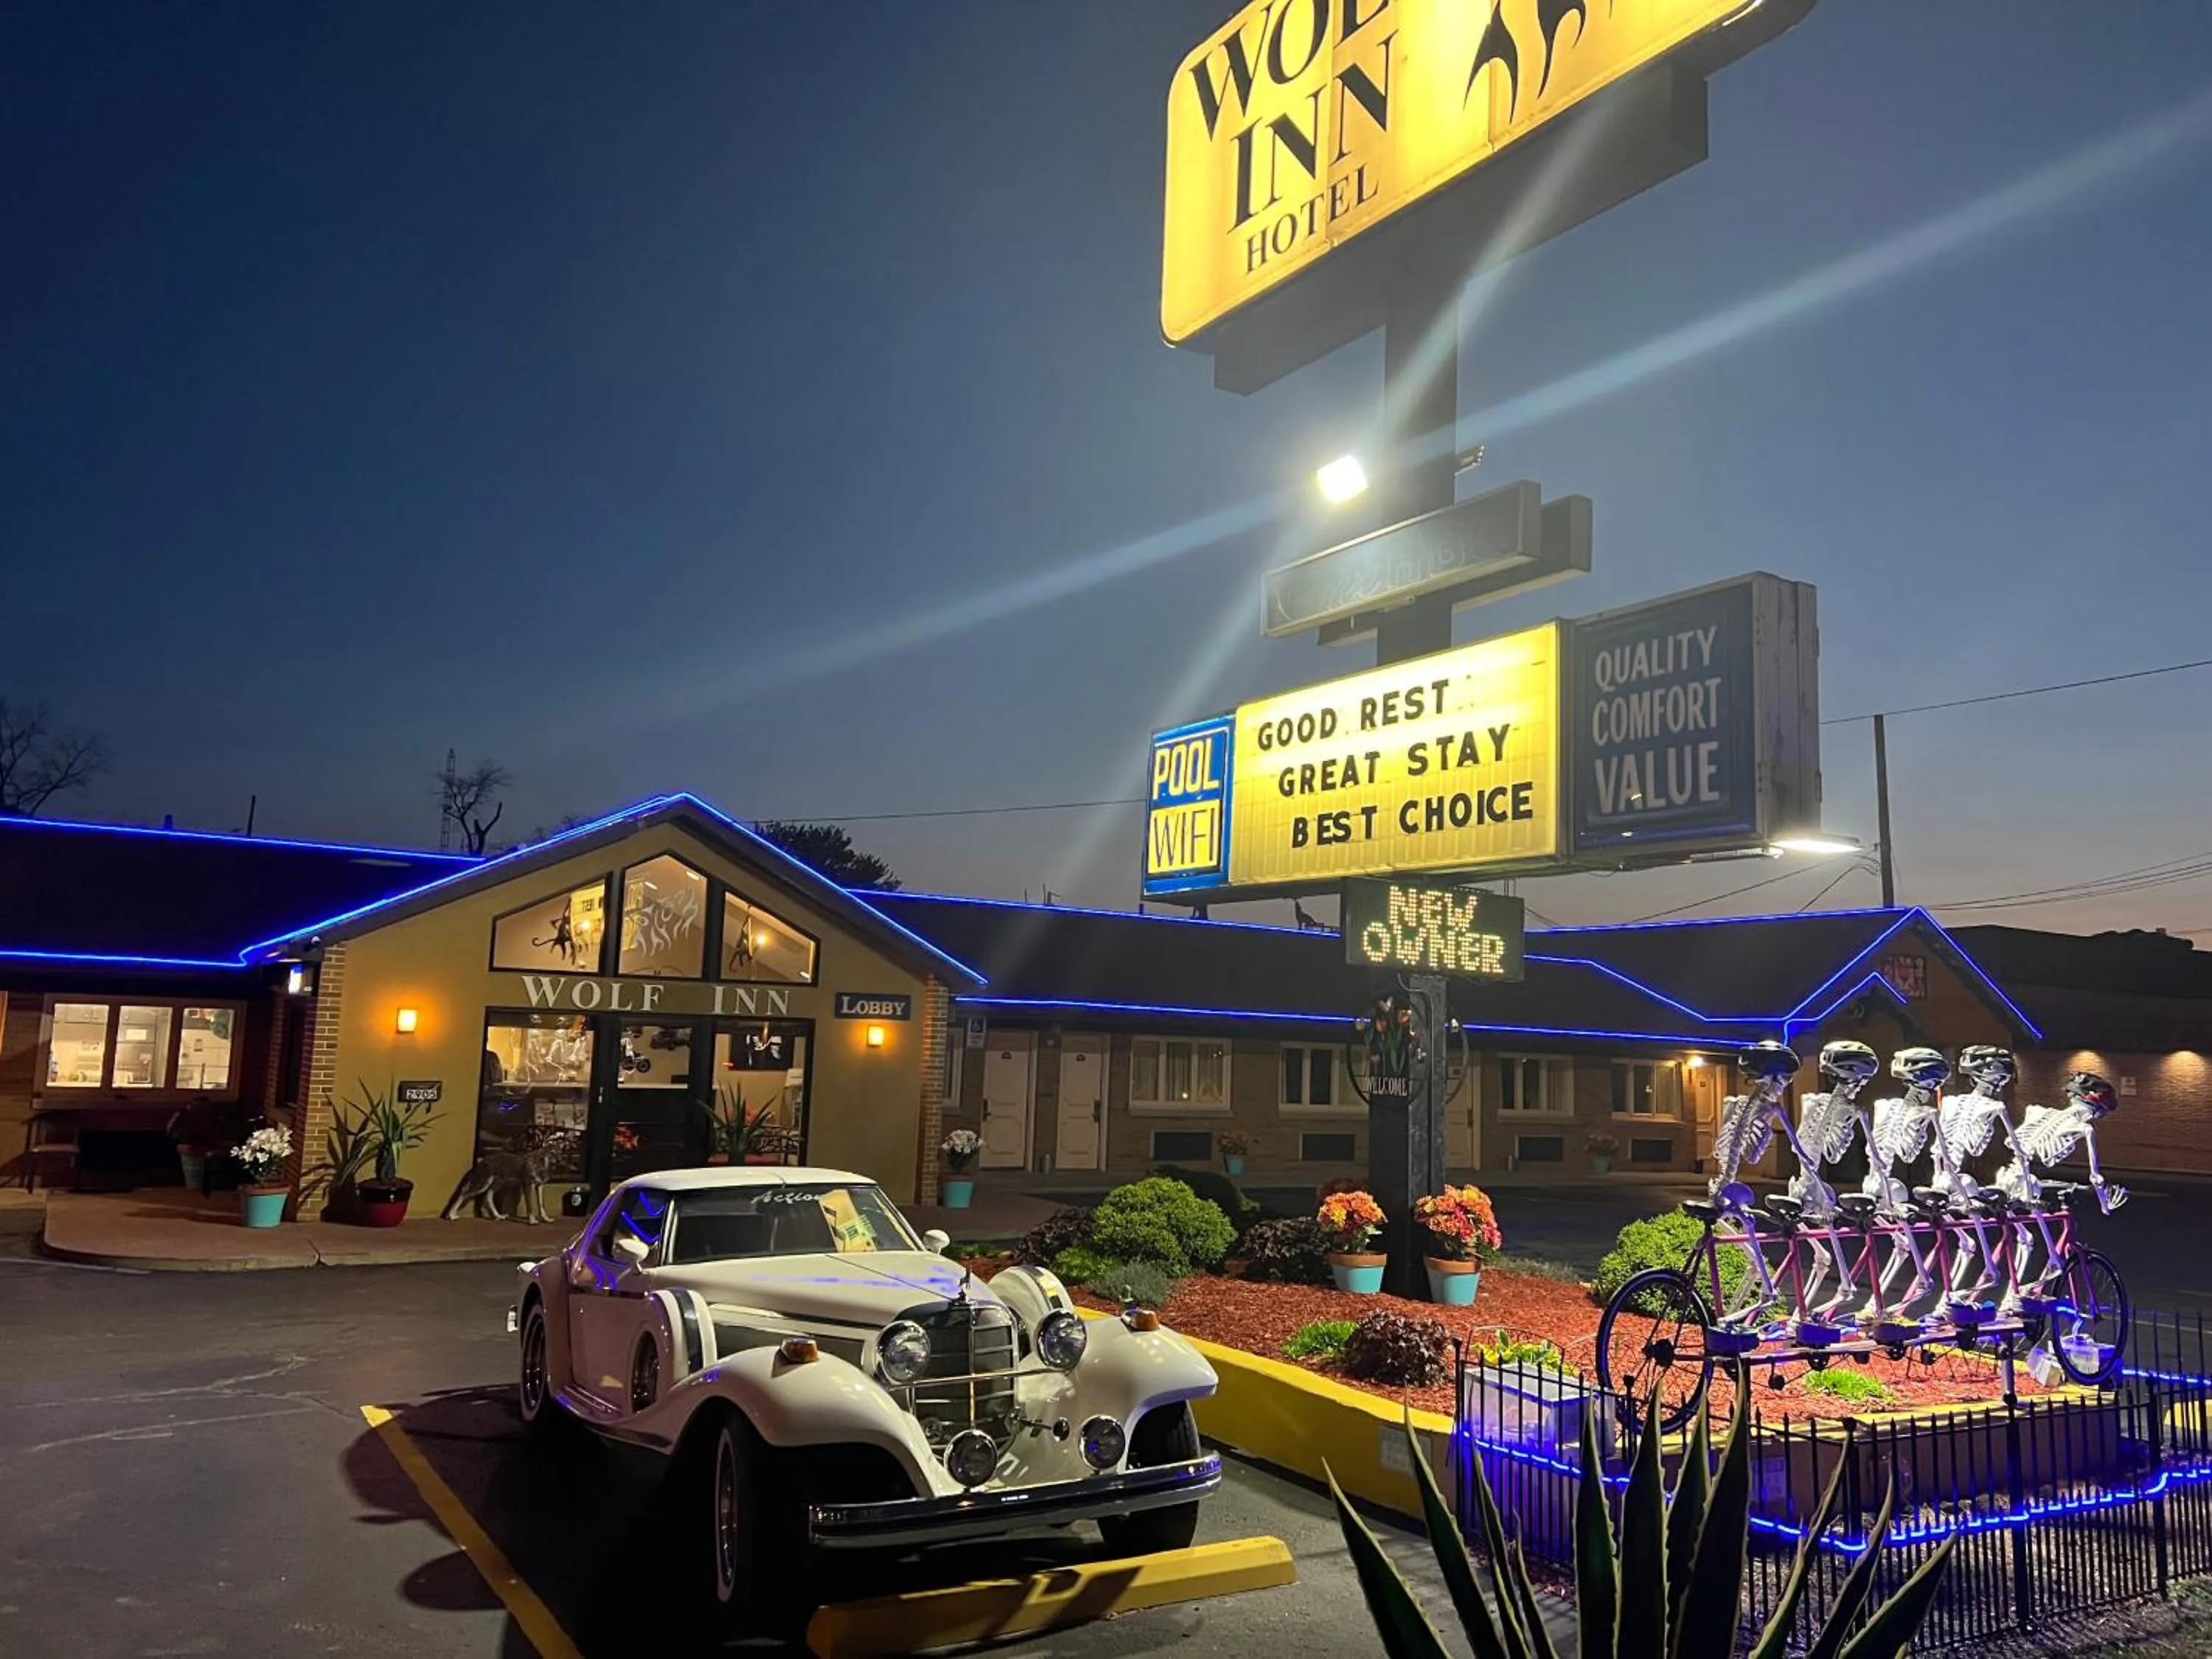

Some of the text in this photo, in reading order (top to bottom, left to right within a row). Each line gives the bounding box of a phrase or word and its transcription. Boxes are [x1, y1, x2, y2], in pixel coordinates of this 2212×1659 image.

[1188, 0, 1391, 142] WOL
[1227, 29, 1399, 234] INN
[1246, 162, 1379, 275] HOTEL
[1594, 625, 1717, 693] QUALITY
[1257, 678, 1449, 751] GOOD REST
[1592, 677, 1722, 747] COMFORT
[1152, 738, 1220, 801] POOL
[1278, 723, 1510, 797] GREAT STAY
[1594, 740, 1720, 815] VALUE
[1153, 807, 1215, 868] WIFI
[1292, 781, 1534, 848] BEST CHOICE
[1389, 886, 1478, 931] NEW
[1363, 922, 1506, 973] OWNER
[521, 975, 790, 1016] WOLF INN
[841, 996, 905, 1015] LOBBY
[1366, 1076, 1408, 1096] WELCOME
